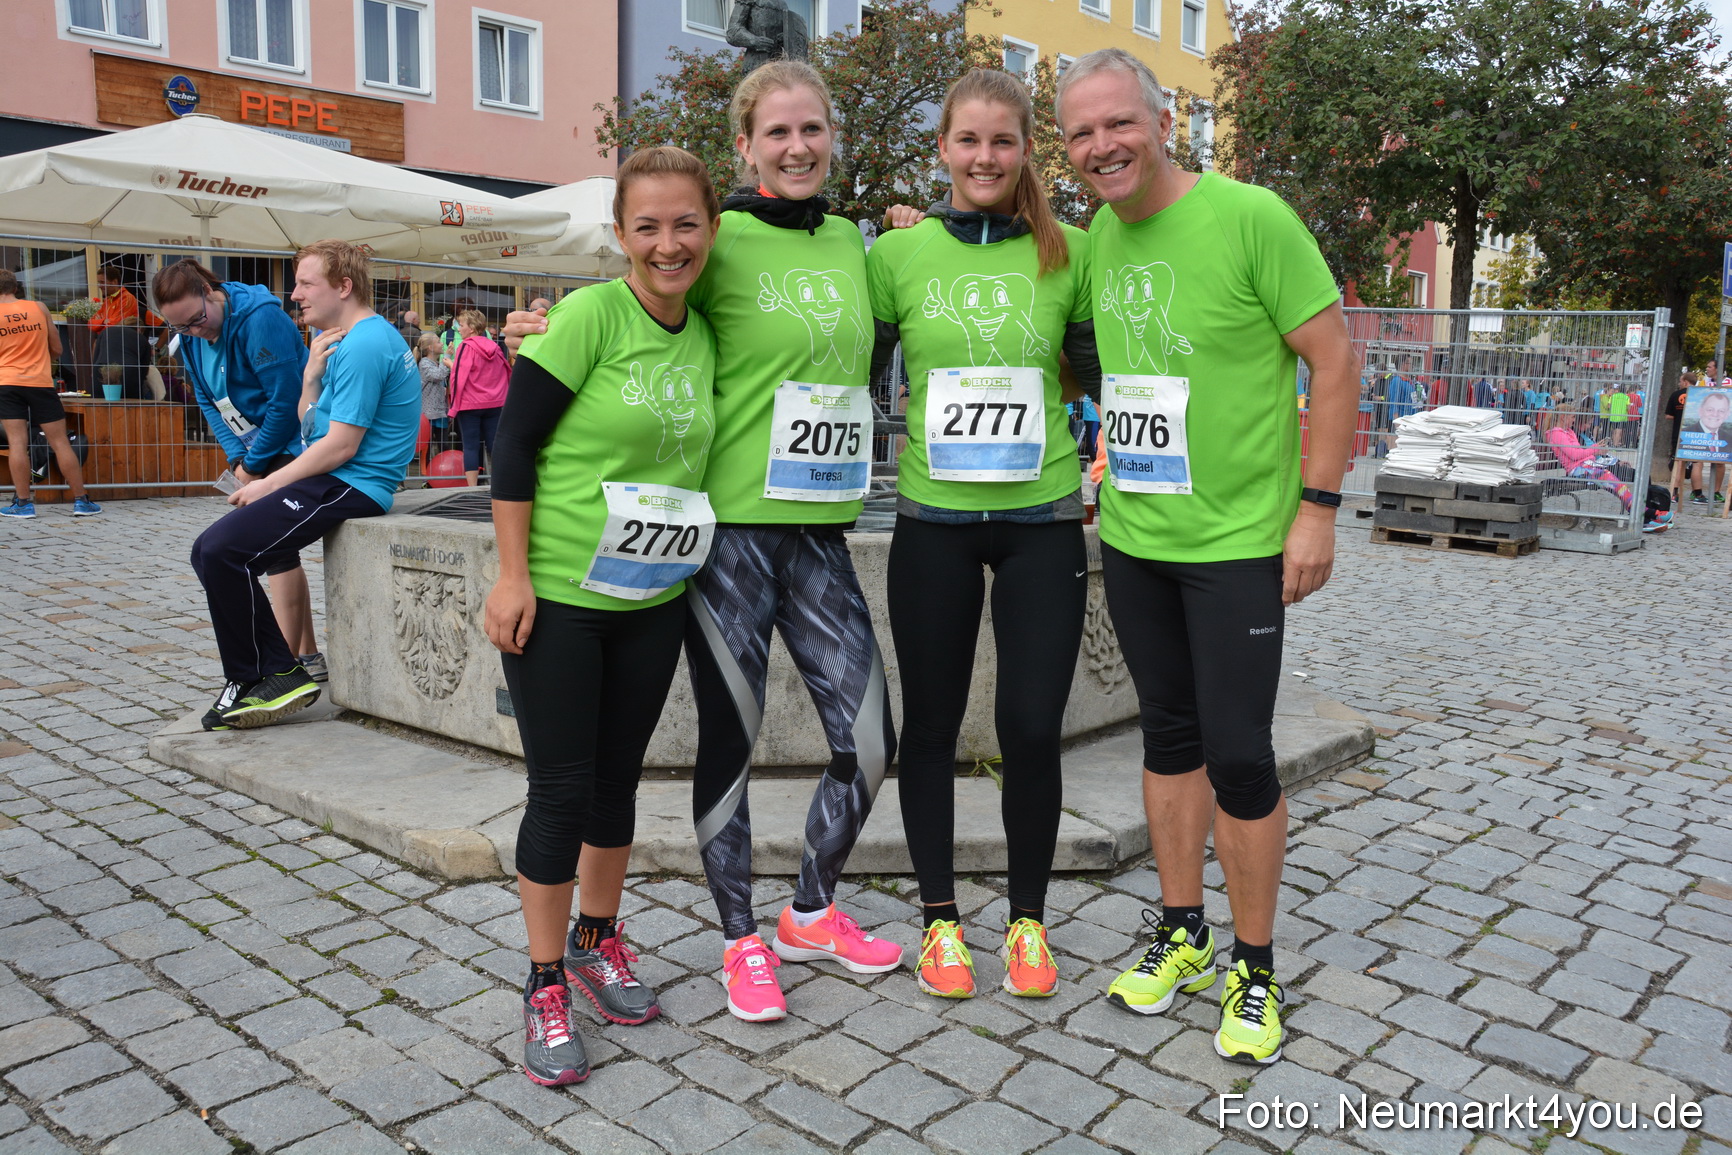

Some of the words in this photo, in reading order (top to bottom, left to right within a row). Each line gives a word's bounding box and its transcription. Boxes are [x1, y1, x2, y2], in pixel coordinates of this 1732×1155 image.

[168, 90, 197, 101] Tucher
[240, 89, 339, 133] PEPE
[176, 169, 268, 199] Tucher
[466, 204, 494, 216] PEPE
[4, 312, 28, 323] TSV
[0, 322, 42, 337] Dietfurt
[972, 376, 1012, 388] BOCK
[1122, 385, 1155, 397] BOCK
[943, 402, 1028, 436] 2777
[1106, 410, 1170, 448] 2076
[788, 419, 861, 456] 2075
[1116, 457, 1154, 473] Michael
[809, 468, 842, 481] Teresa
[651, 495, 683, 510] BOCK
[616, 519, 699, 557] 2770
[389, 543, 430, 562] NEUMARKT
[1249, 626, 1277, 636] Reebok
